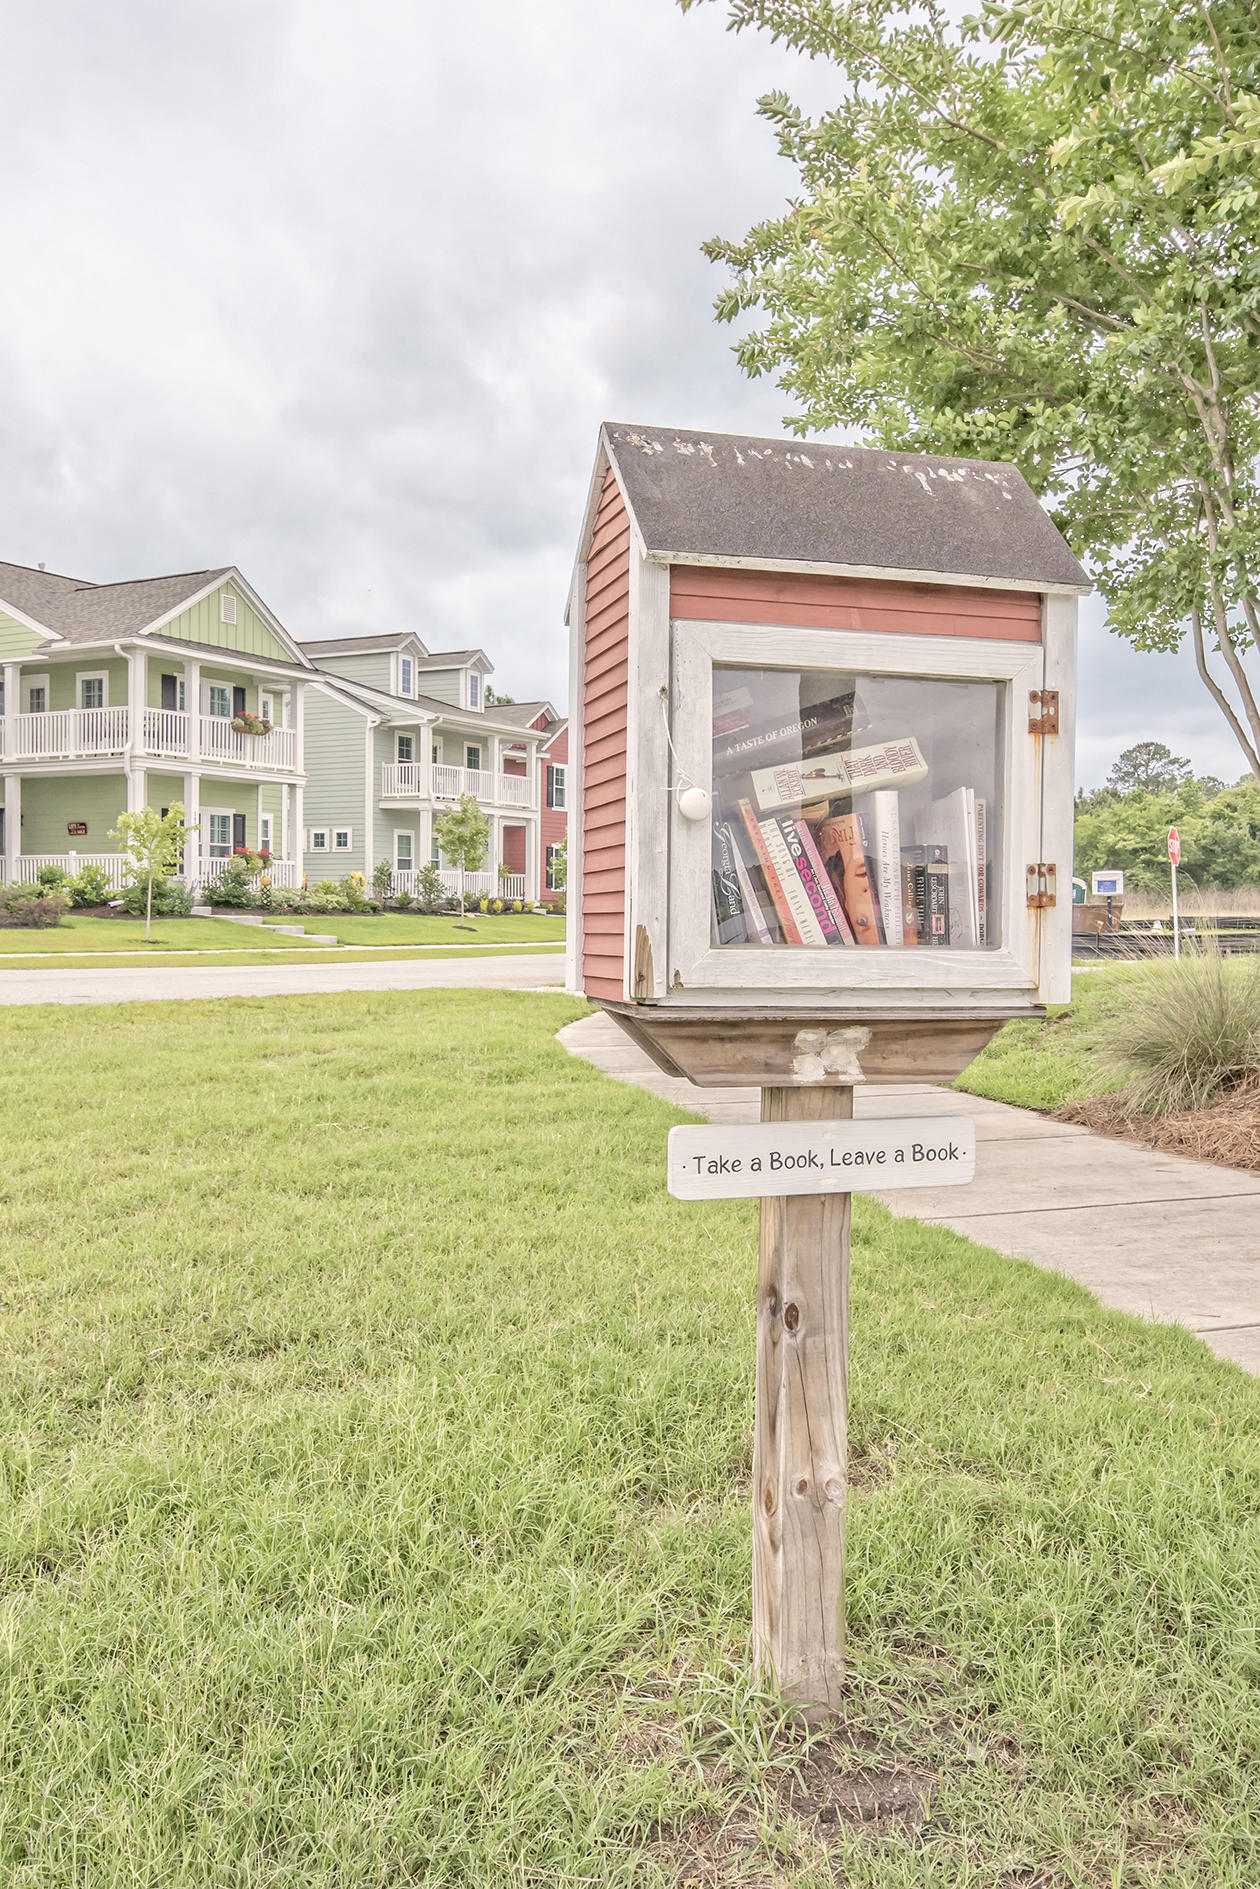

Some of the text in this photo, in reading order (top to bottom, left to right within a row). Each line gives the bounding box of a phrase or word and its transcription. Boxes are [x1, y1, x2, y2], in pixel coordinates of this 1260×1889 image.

[726, 717, 818, 756] A TASTE OF OREGON
[860, 754, 877, 777] DARK
[872, 754, 890, 770] AND
[883, 746, 906, 774] BLOODY
[898, 744, 919, 768] RIVER
[786, 769, 804, 796] ECKERT
[845, 759, 863, 780] THAT
[777, 778, 792, 801] ALLAN
[977, 843, 985, 864] ISN'T
[713, 821, 741, 915] Georgia Land
[781, 819, 802, 857] live
[795, 856, 837, 935] second
[881, 830, 892, 929] Heroes Are My Weakness
[906, 882, 914, 908] Calling
[936, 885, 945, 905] JOHN
[692, 1142, 959, 1175] Take a Book, Leave a Book
